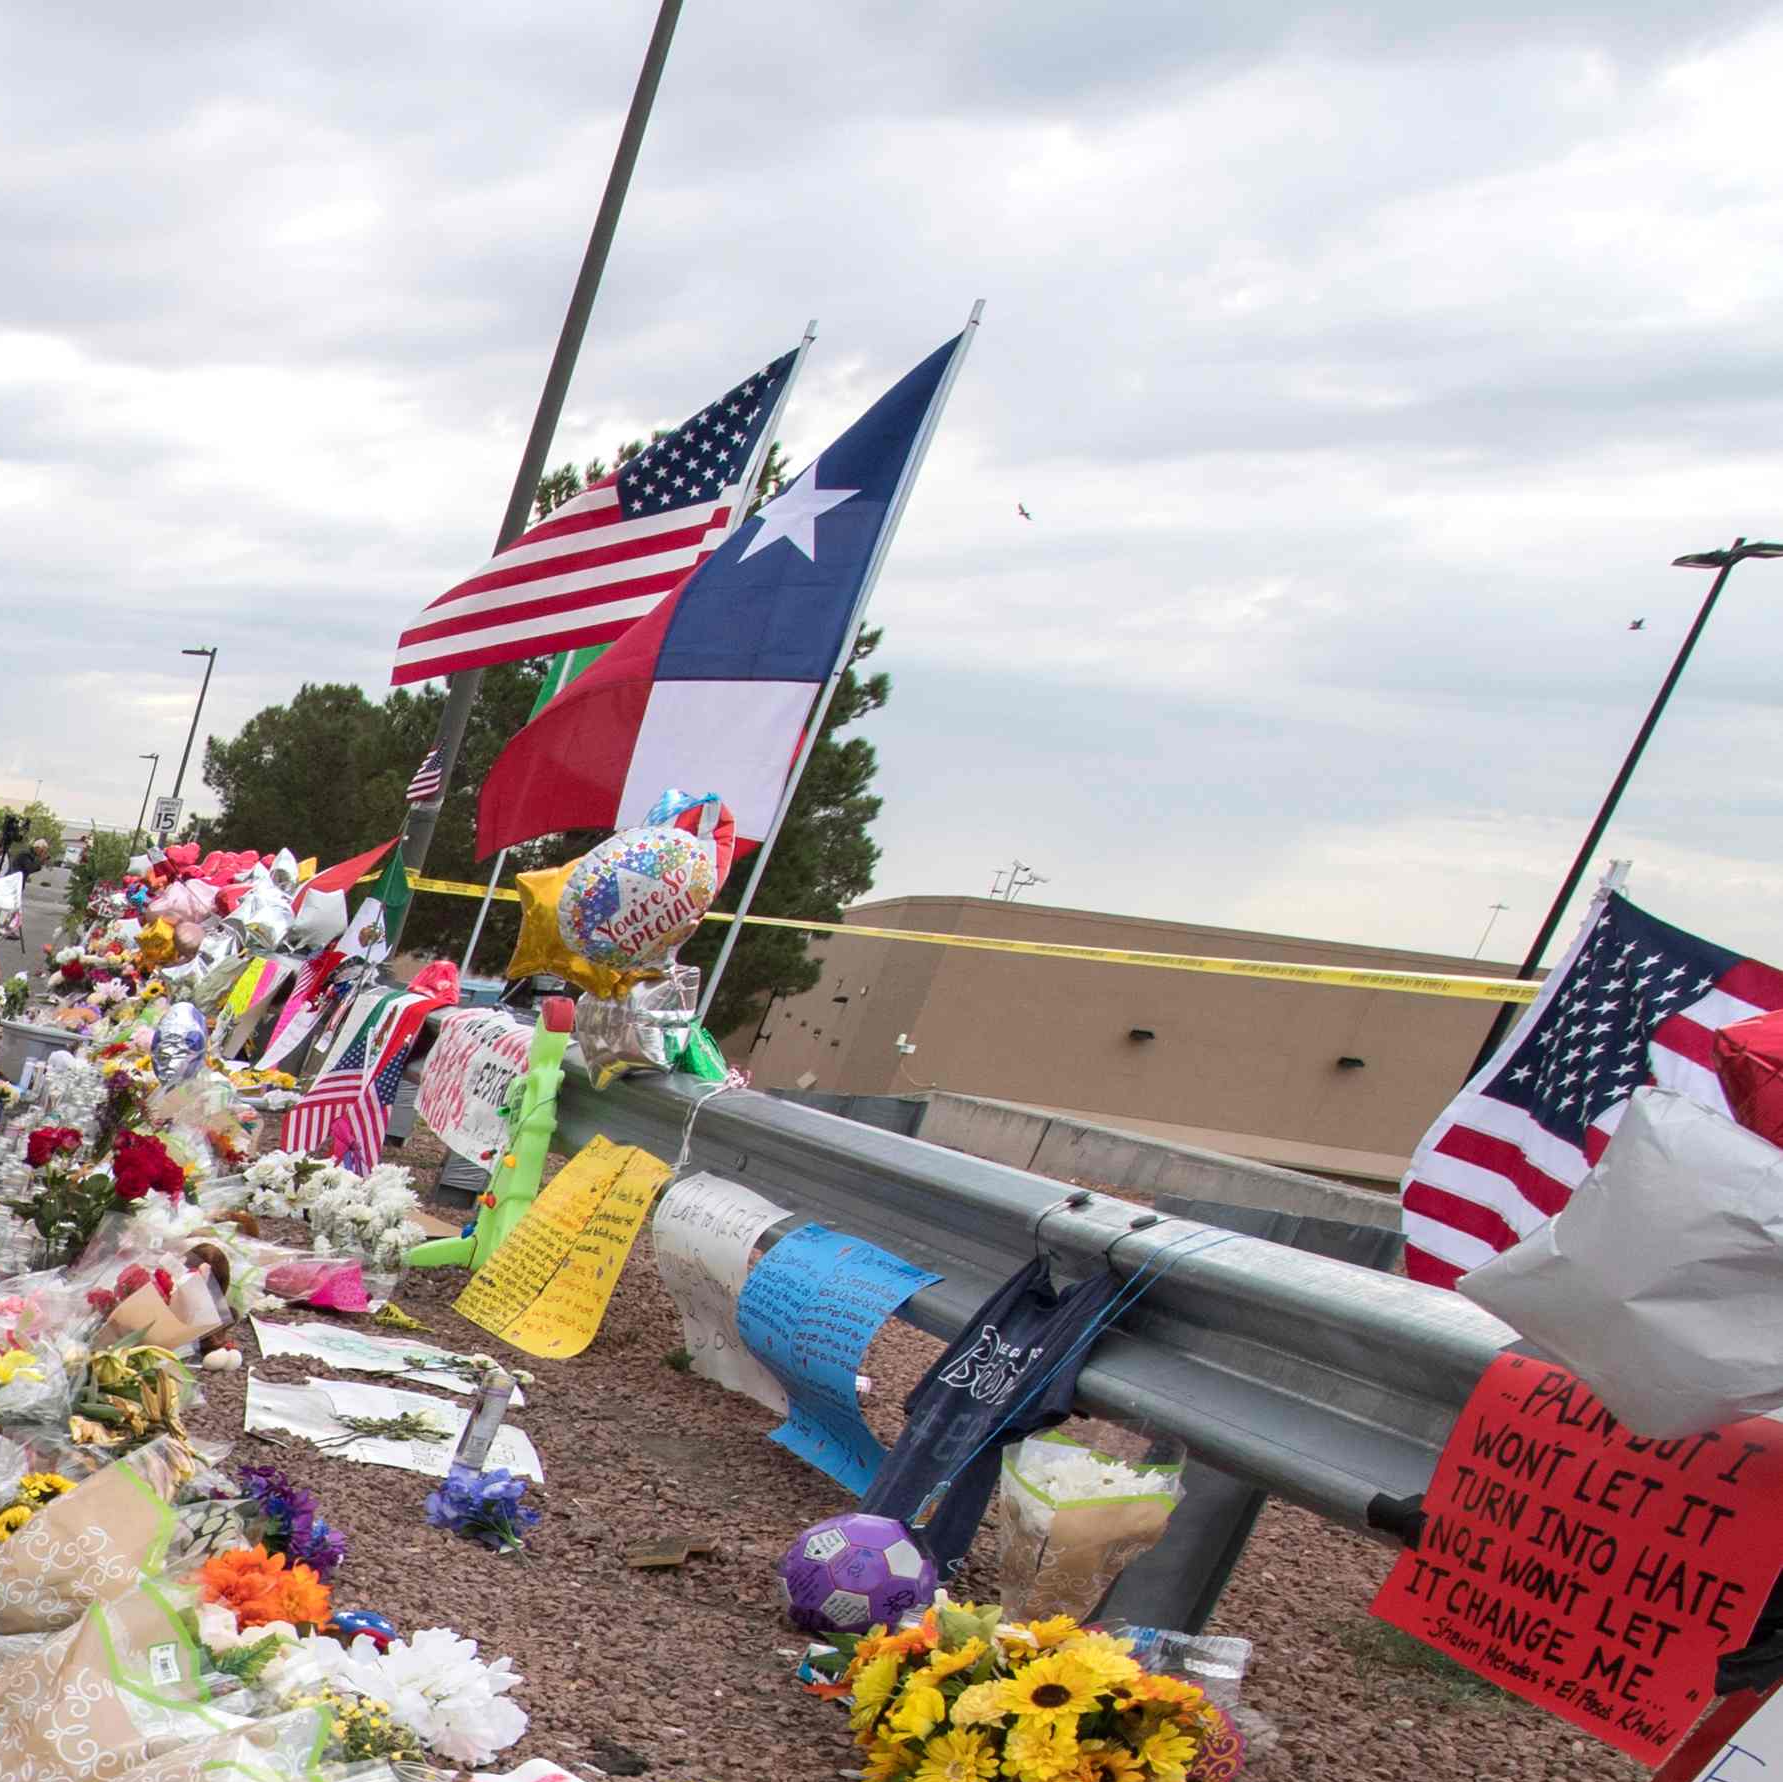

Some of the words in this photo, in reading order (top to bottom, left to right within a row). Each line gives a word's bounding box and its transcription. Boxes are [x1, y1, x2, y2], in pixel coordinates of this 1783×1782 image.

[155, 812, 176, 830] 15
[660, 867, 687, 898] So
[1471, 1416, 1577, 1486] WON'T
[1573, 1456, 1665, 1519] LET
[1665, 1496, 1734, 1547] IT
[1716, 1443, 1765, 1486] I
[1450, 1466, 1529, 1531] TURN
[1527, 1505, 1619, 1577] INTO
[1403, 1559, 1442, 1597] IT
[1445, 1579, 1576, 1666] CHANGE
[1501, 1547, 1590, 1616] WON'T
[1596, 1597, 1681, 1660] LET
[1482, 1641, 1541, 1685] Mendes
[1558, 1680, 1576, 1701] El
[1615, 1706, 1676, 1746] Khalid
